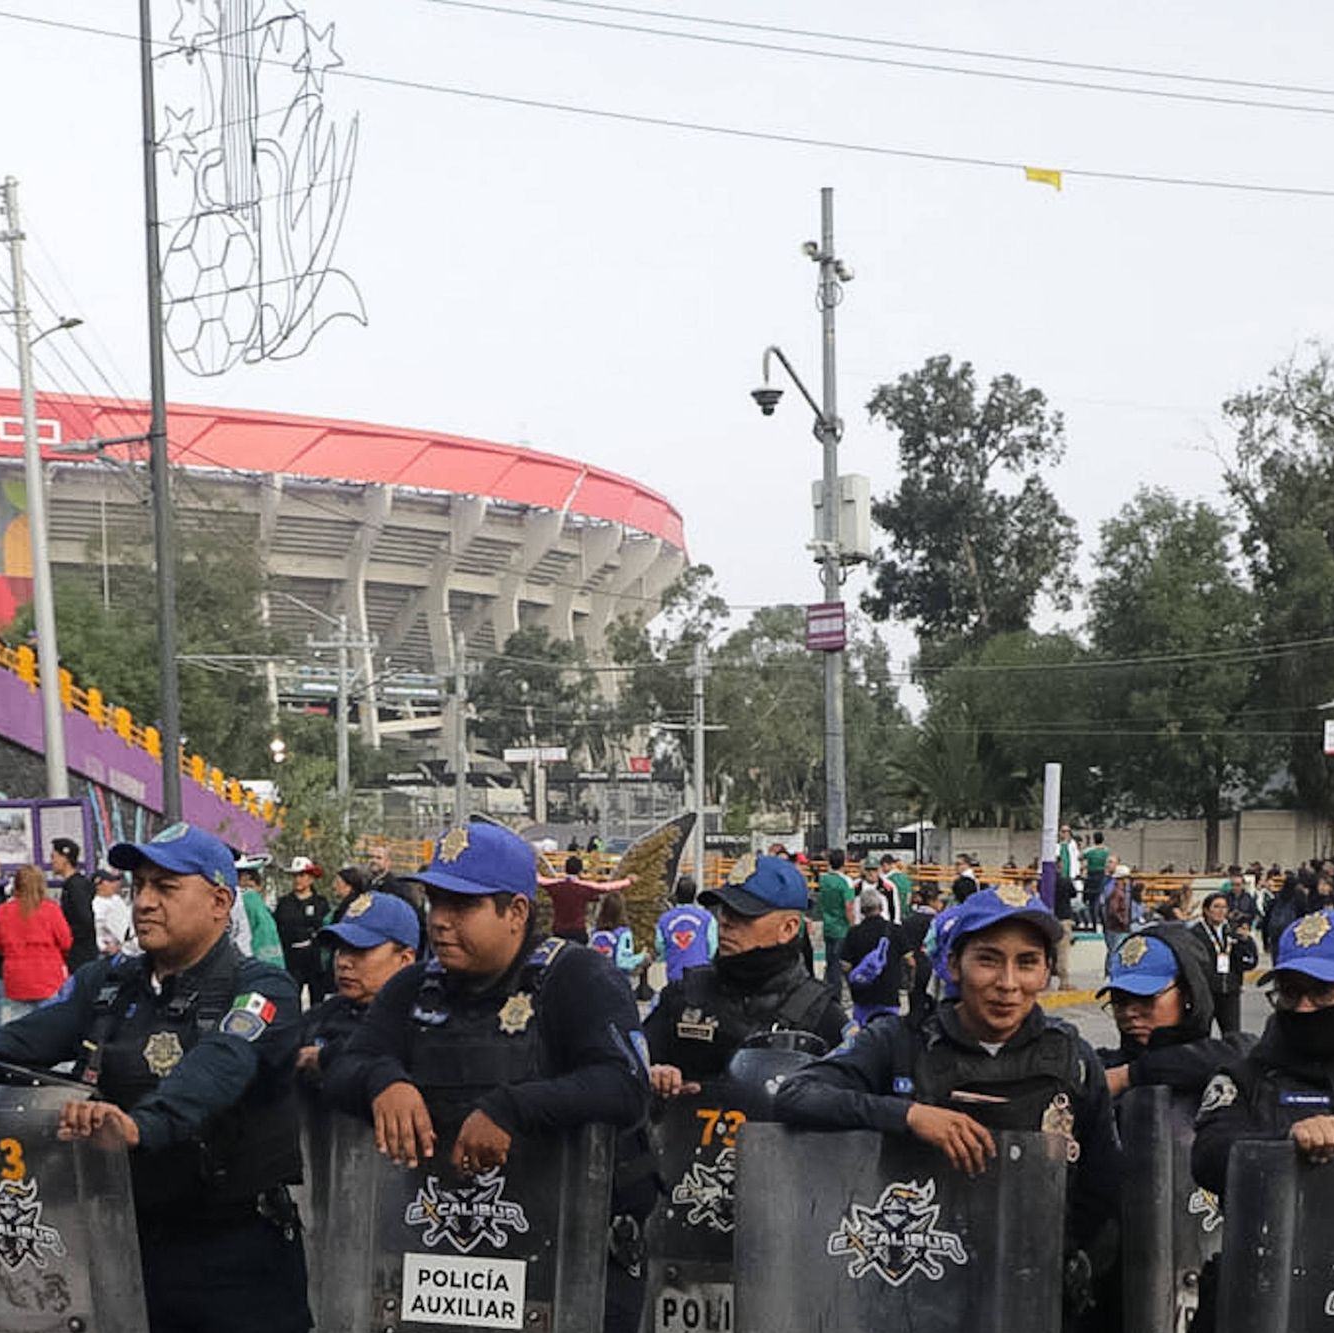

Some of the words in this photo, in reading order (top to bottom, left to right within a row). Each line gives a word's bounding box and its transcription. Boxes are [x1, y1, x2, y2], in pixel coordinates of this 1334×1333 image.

[408, 1203, 527, 1230] EXCALIBUR
[832, 1231, 961, 1257] EXCALIBUR
[417, 1263, 510, 1292] POLICÍA
[410, 1296, 516, 1321] AUXILIAR
[663, 1298, 732, 1331] POLI
